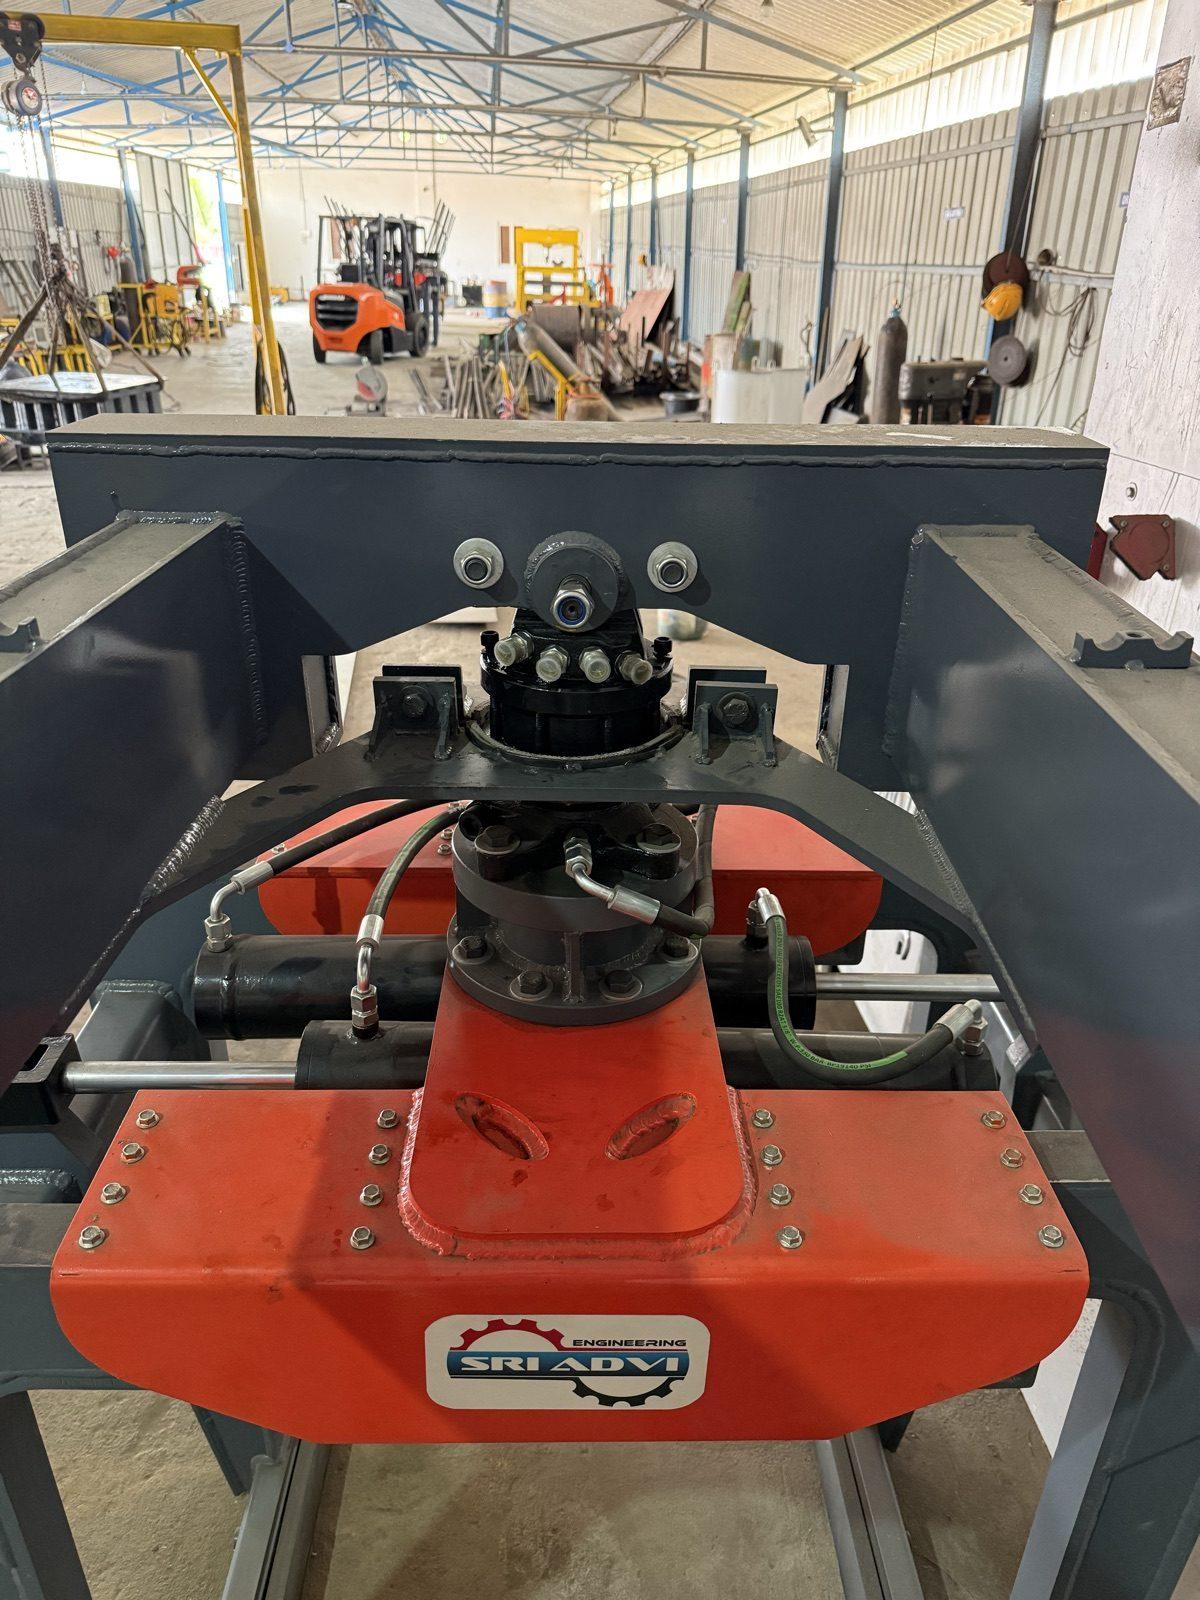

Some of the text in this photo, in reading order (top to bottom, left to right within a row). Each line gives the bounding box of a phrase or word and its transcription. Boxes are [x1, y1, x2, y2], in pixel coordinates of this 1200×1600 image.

[572, 1339, 687, 1347] ENGINEERING
[461, 1356, 679, 1372] SRI ADVI
